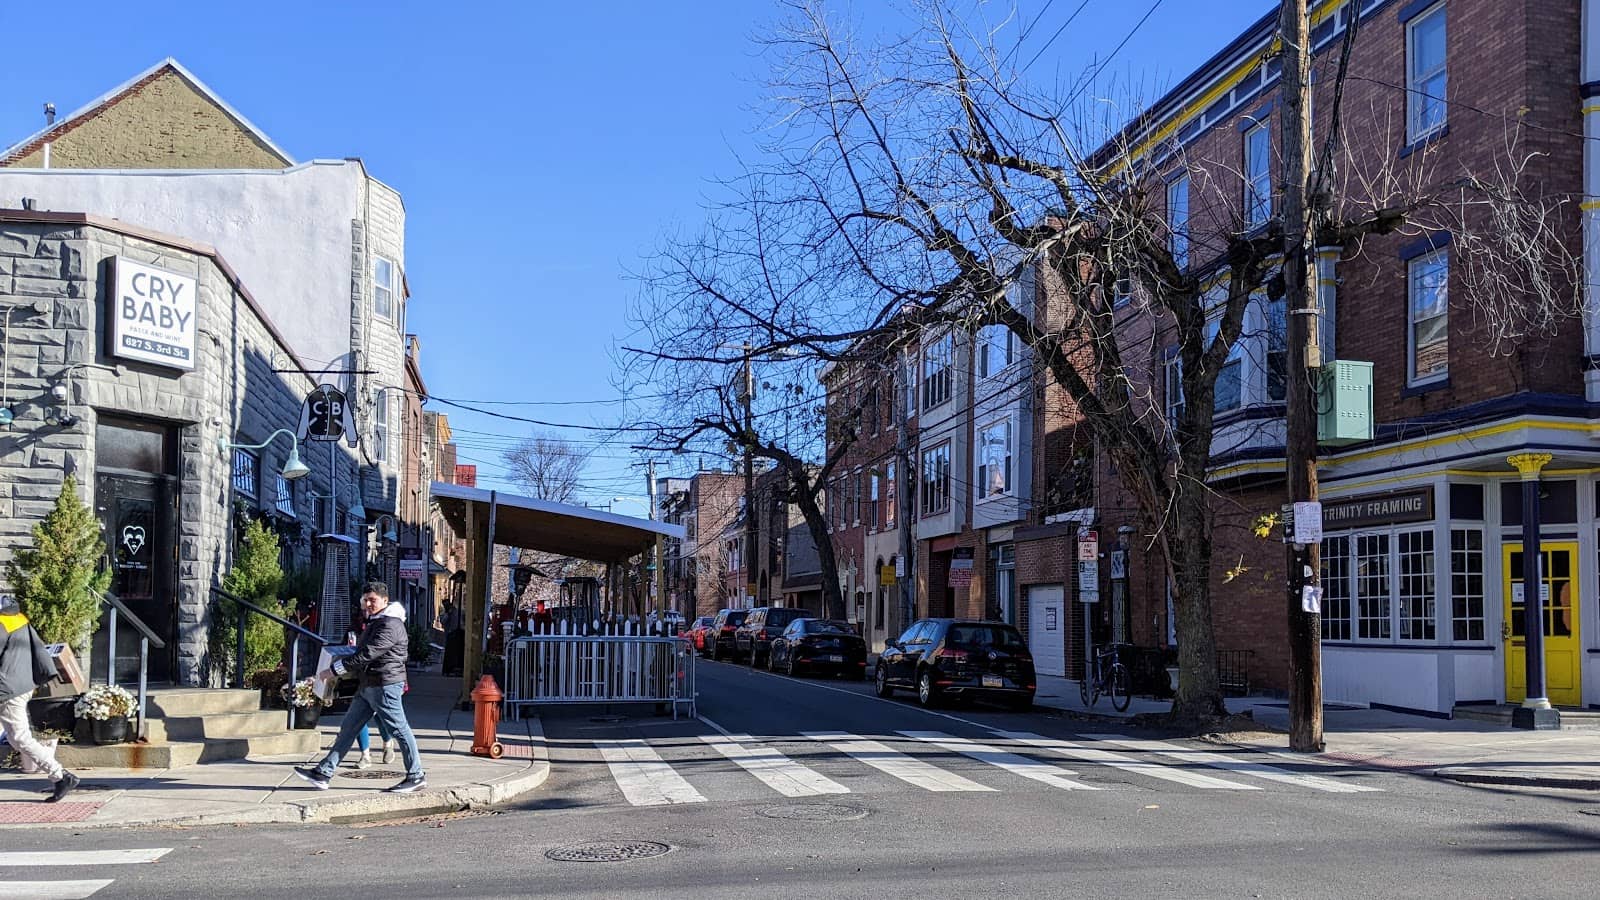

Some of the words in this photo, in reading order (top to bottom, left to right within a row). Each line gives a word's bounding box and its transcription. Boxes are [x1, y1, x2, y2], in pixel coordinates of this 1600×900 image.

[132, 272, 184, 304] CRY
[123, 295, 191, 332] BABY
[150, 330, 164, 338] AND
[125, 337, 143, 348] 627
[144, 341, 154, 351] S.
[156, 344, 172, 354] 3rd
[172, 348, 187, 358] St.
[313, 401, 323, 415] C
[331, 401, 342, 415] B
[1323, 504, 1363, 521] TRINITY
[1367, 498, 1422, 516] FRAMING
